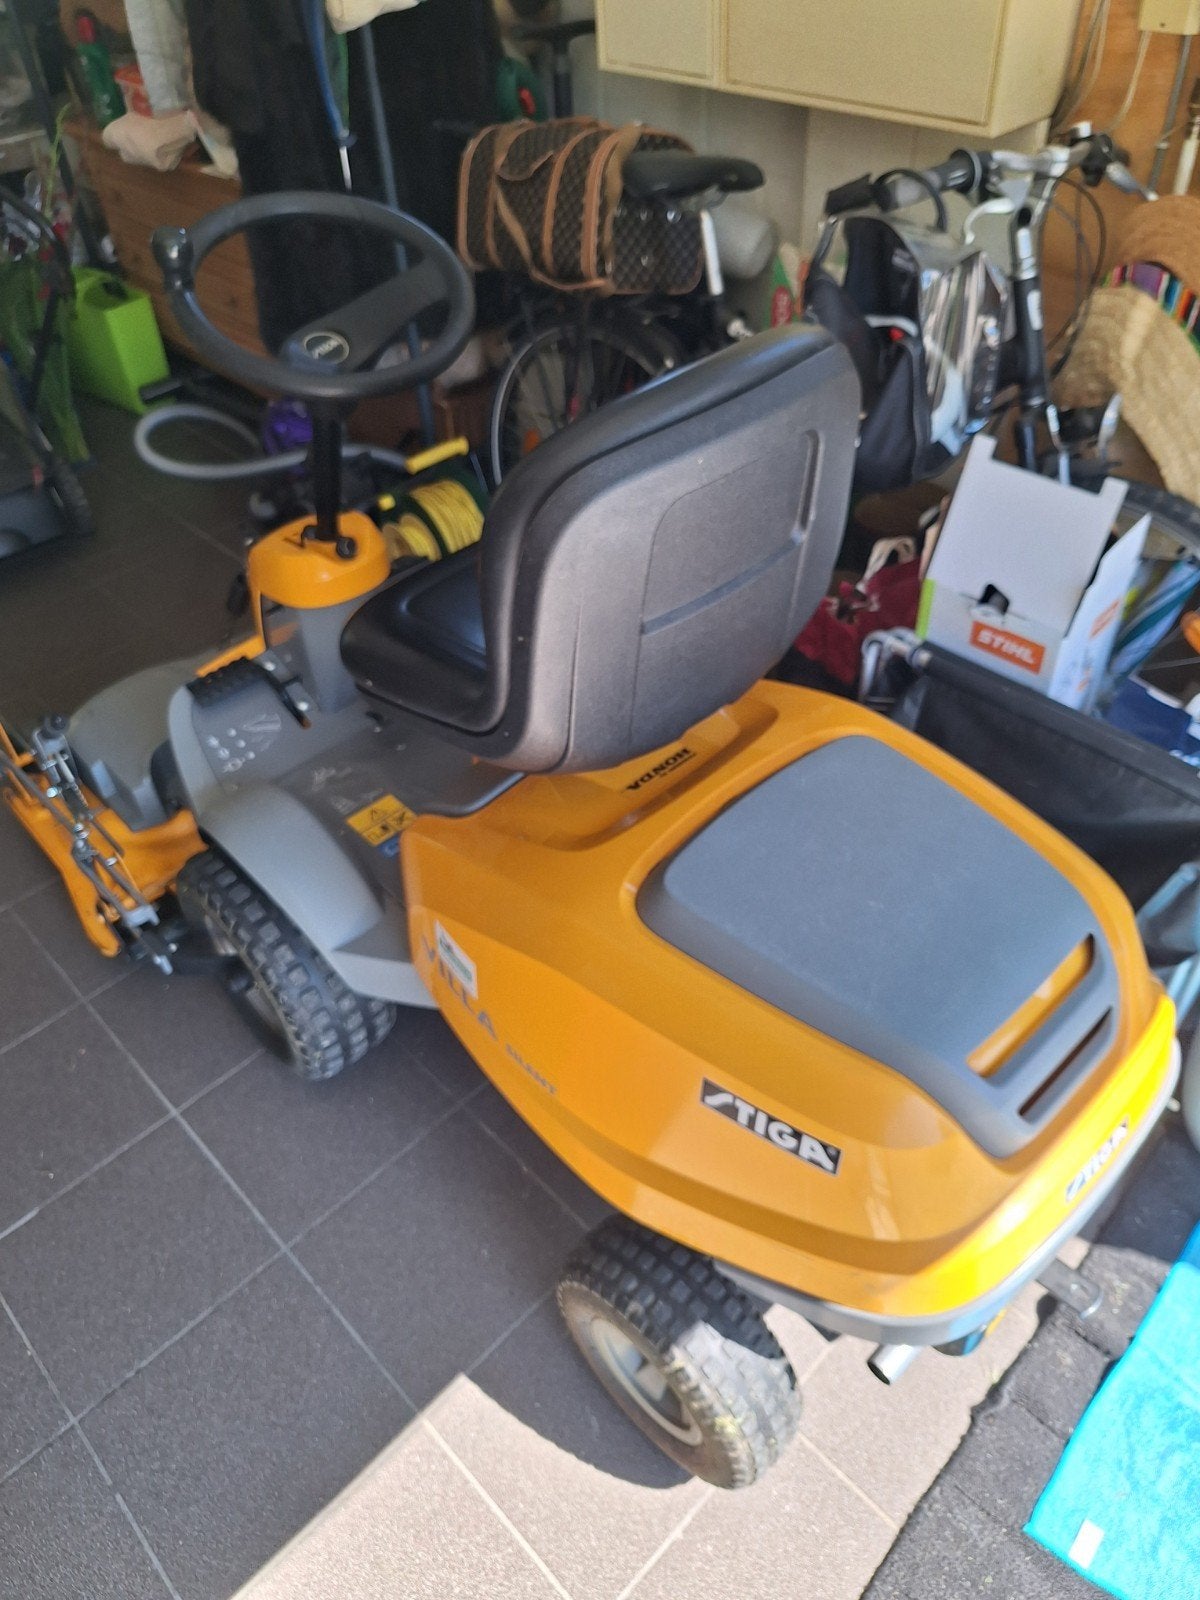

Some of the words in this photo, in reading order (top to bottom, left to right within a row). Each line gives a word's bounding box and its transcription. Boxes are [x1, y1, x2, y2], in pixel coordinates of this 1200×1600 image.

[978, 629, 1034, 664] STIHL
[626, 748, 690, 790] HONDA
[703, 1091, 836, 1172] STIGA
